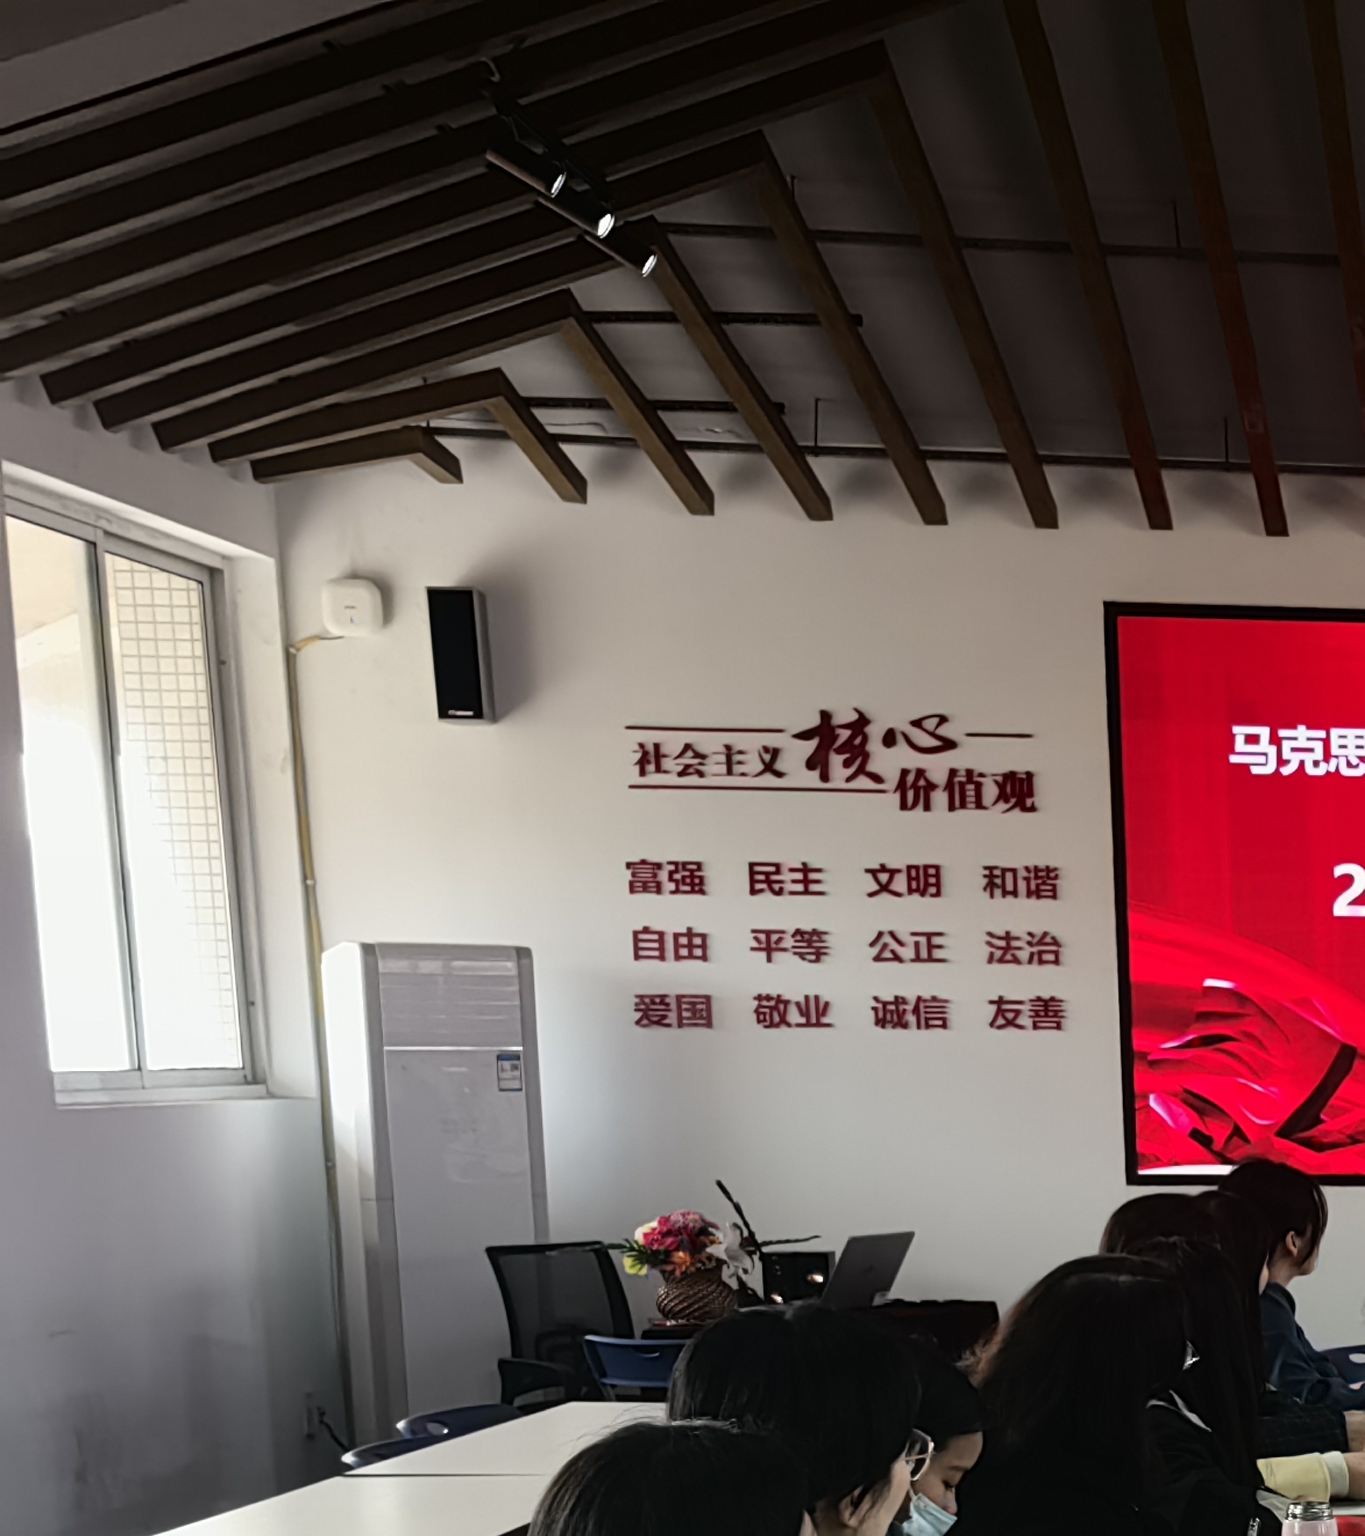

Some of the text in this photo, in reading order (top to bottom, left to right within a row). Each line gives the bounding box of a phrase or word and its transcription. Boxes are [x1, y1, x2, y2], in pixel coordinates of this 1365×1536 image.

[634, 707, 1039, 812] 社会主义 核心 价值观
[625, 858, 1060, 899] 富强 民主 文明 和谐
[632, 925, 1063, 965] 自由 平等 公正 法治
[633, 993, 1066, 1030] 爱国 敬业 诚信 友善
